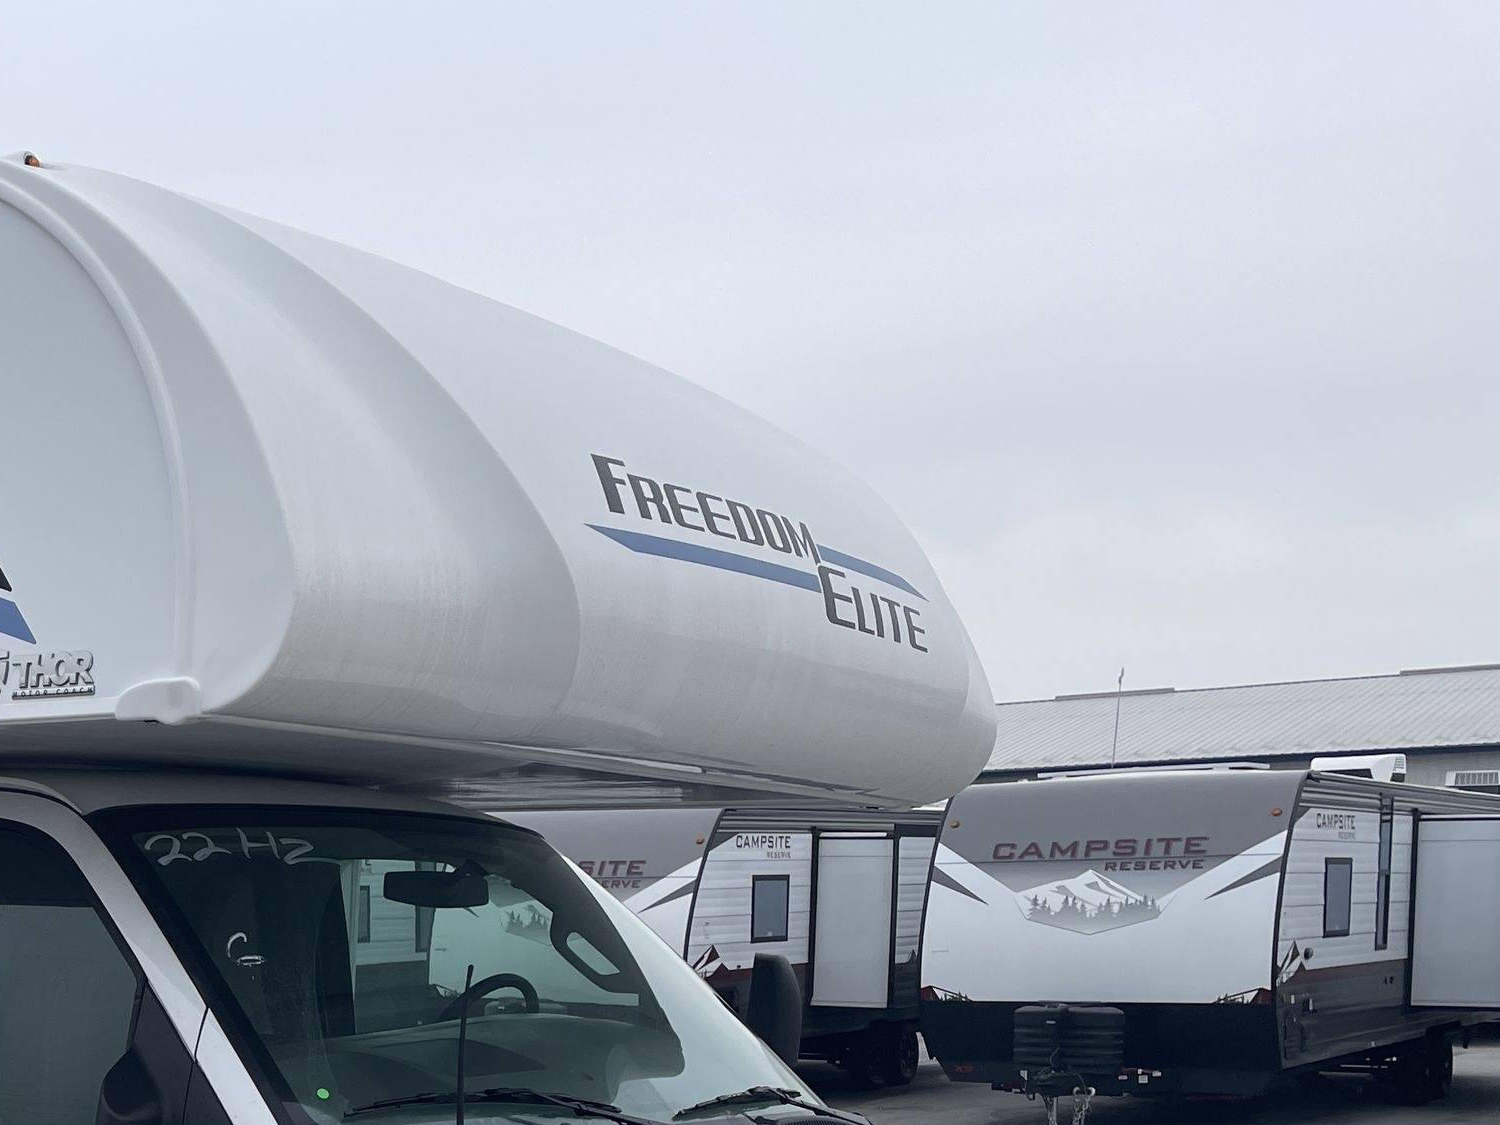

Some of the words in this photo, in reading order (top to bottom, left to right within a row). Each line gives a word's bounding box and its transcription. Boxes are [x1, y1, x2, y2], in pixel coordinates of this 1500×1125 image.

[590, 453, 821, 565] FREEDOM
[818, 564, 929, 654] ELITE
[12, 650, 94, 688] THOR
[12, 689, 48, 698] MOTOR
[1316, 812, 1356, 830] CAMPSITE
[735, 834, 792, 849] CAMPSITE
[992, 836, 1210, 860] CAMPSITE
[579, 859, 647, 877] SITE
[1104, 859, 1205, 872] RESERVE
[602, 879, 642, 889] ERVE
